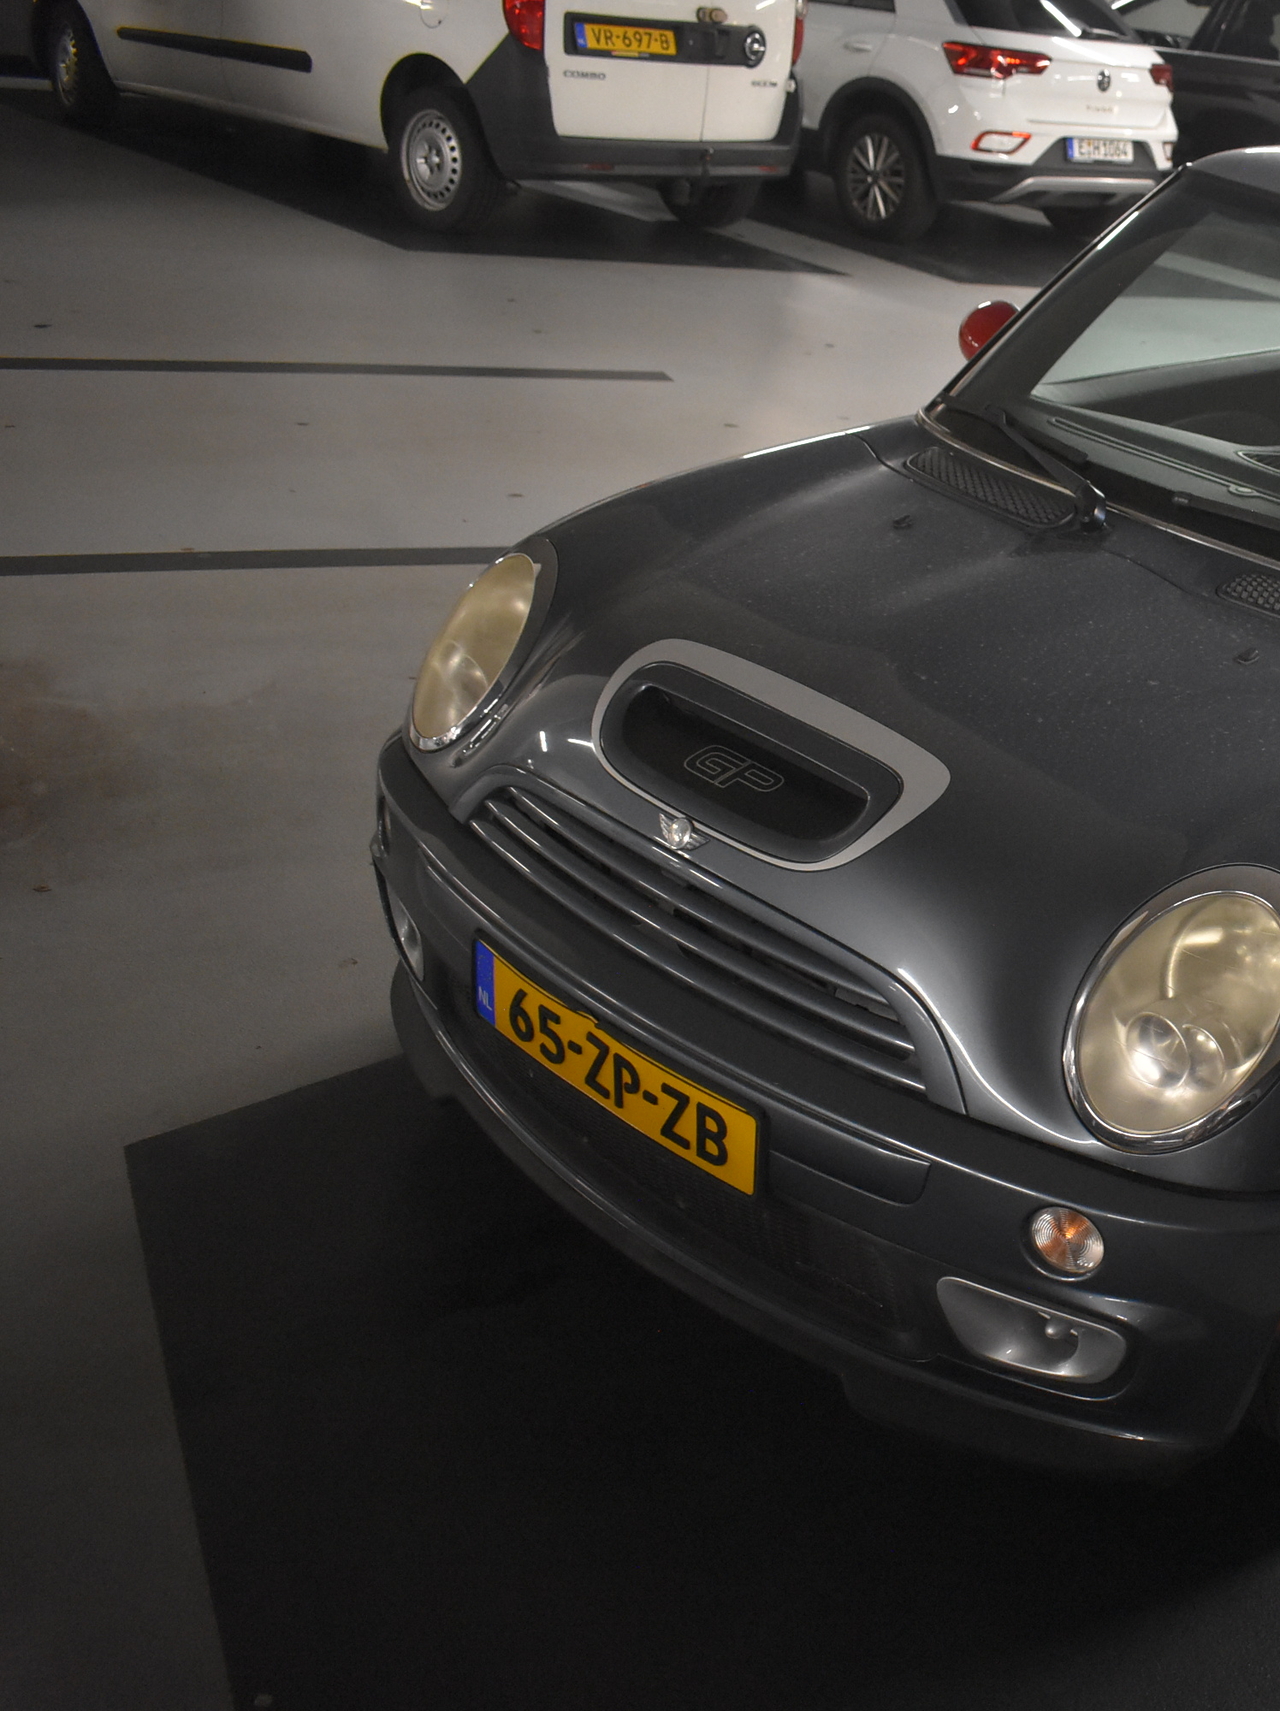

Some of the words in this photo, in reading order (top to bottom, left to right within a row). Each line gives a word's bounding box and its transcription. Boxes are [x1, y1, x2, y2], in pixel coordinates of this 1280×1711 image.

[590, 27, 671, 51] VR-697-B
[684, 744, 785, 793] GP
[478, 985, 493, 1011] NL
[508, 988, 728, 1166] 65-ZP-ZB
